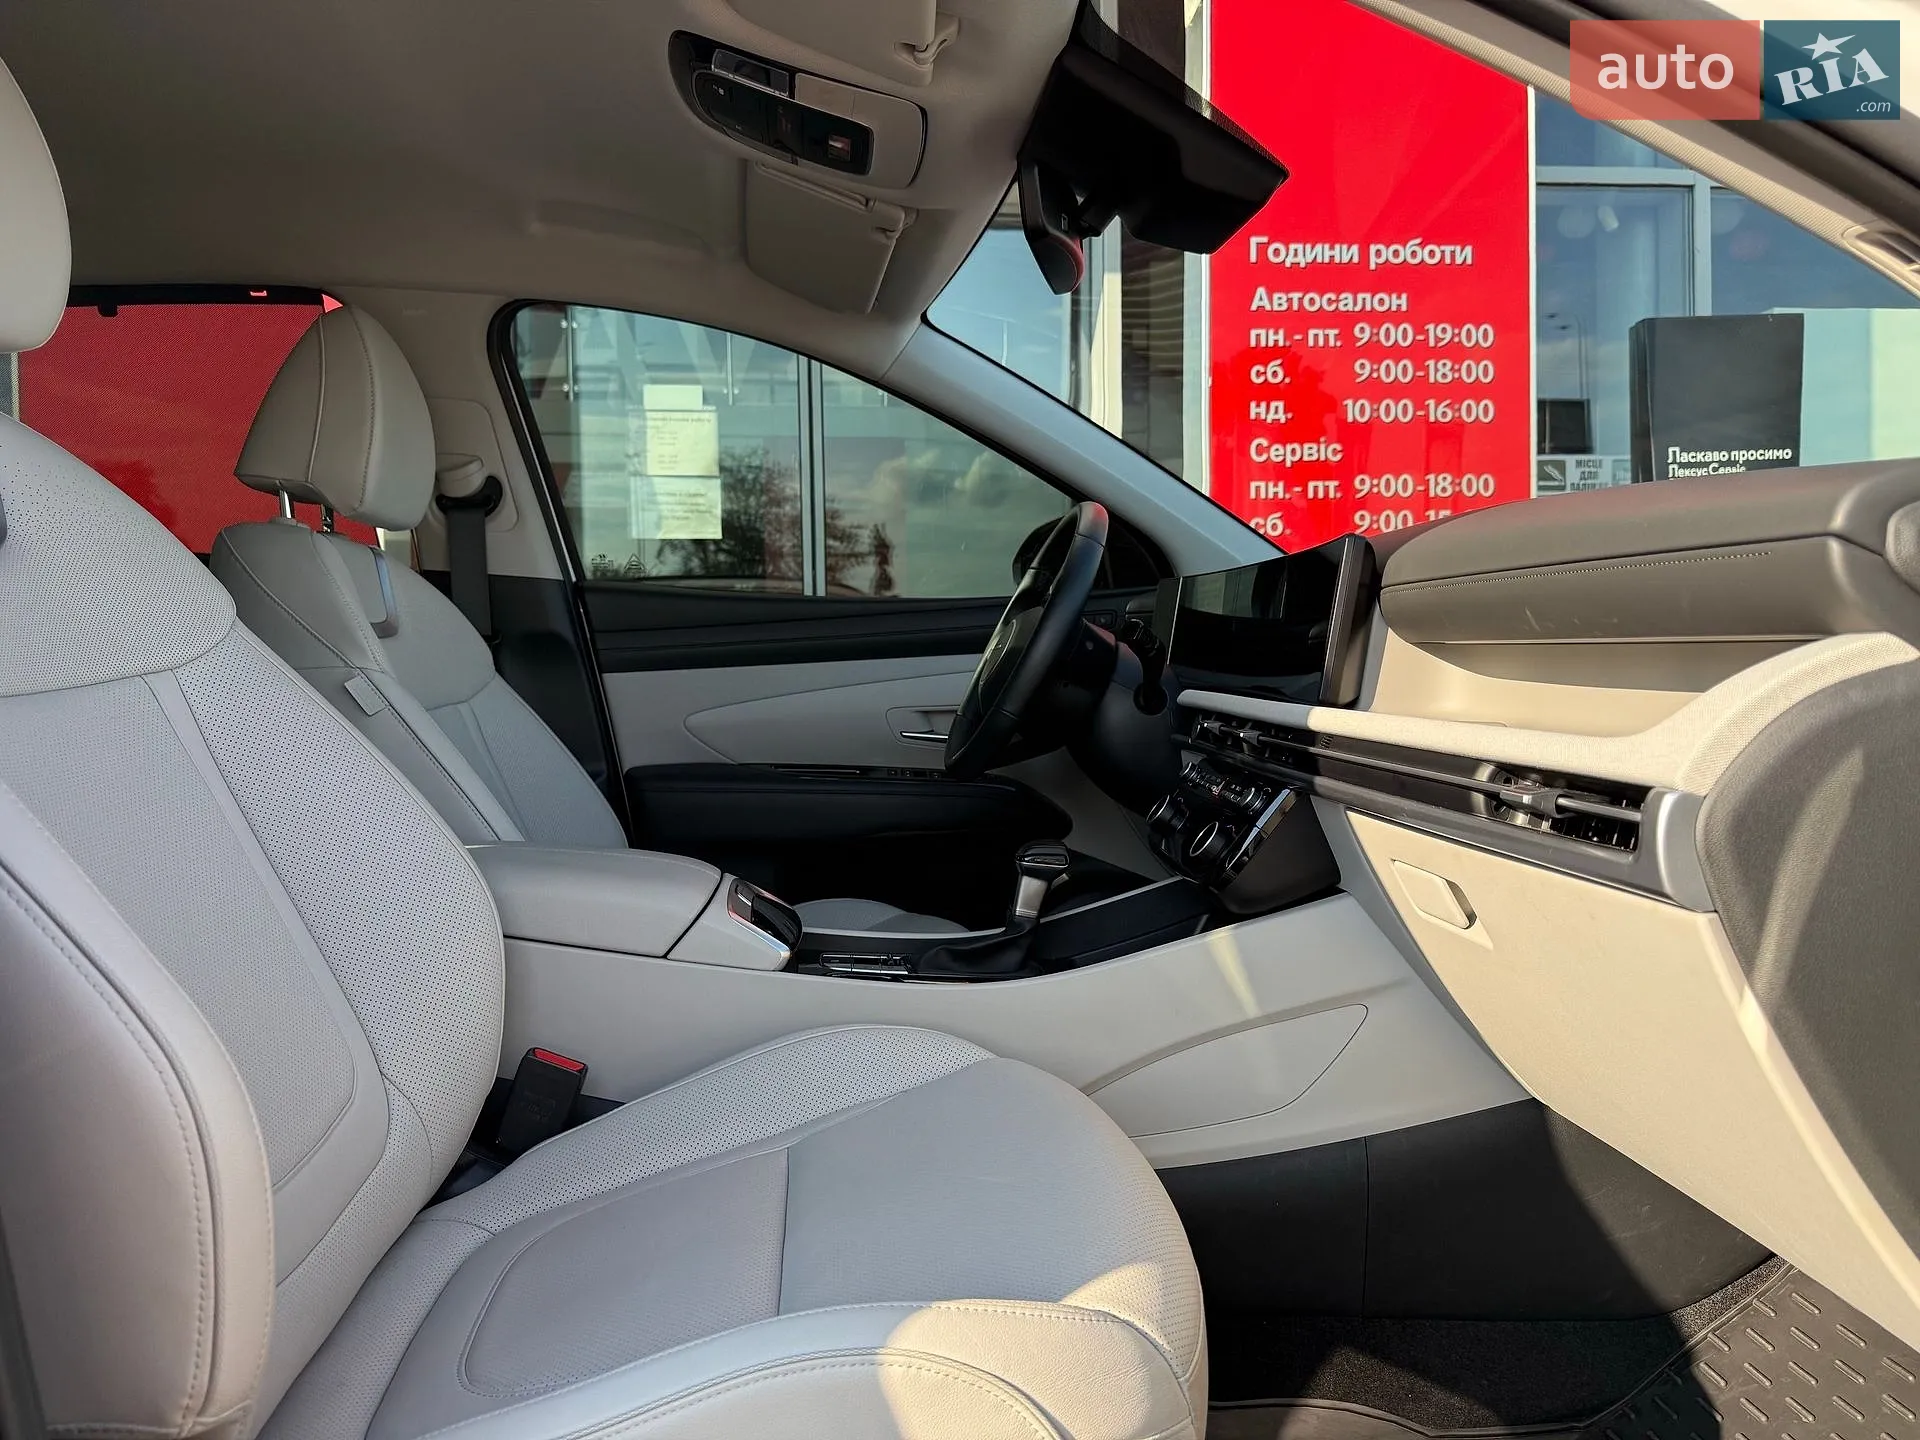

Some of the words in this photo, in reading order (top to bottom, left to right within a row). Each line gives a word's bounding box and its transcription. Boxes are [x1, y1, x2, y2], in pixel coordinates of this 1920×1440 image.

[1249, 236, 1360, 268] Години
[1369, 238, 1473, 270] роботи
[1250, 286, 1408, 312] Автосалон
[1307, 328, 1342, 348] пт.
[1353, 322, 1495, 348] 9:00-19:00
[1250, 358, 1291, 384] сб.
[1353, 359, 1495, 384] 9:00-18:00
[1249, 400, 1293, 424] нд.
[1342, 399, 1495, 424] 10:00-16:00
[1250, 437, 1344, 467] Сервіс
[1667, 446, 1729, 463] Ласкаво
[1730, 448, 1792, 464] просимо
[1353, 473, 1495, 498] 9:00-18:00
[1250, 511, 1292, 537] сб.
